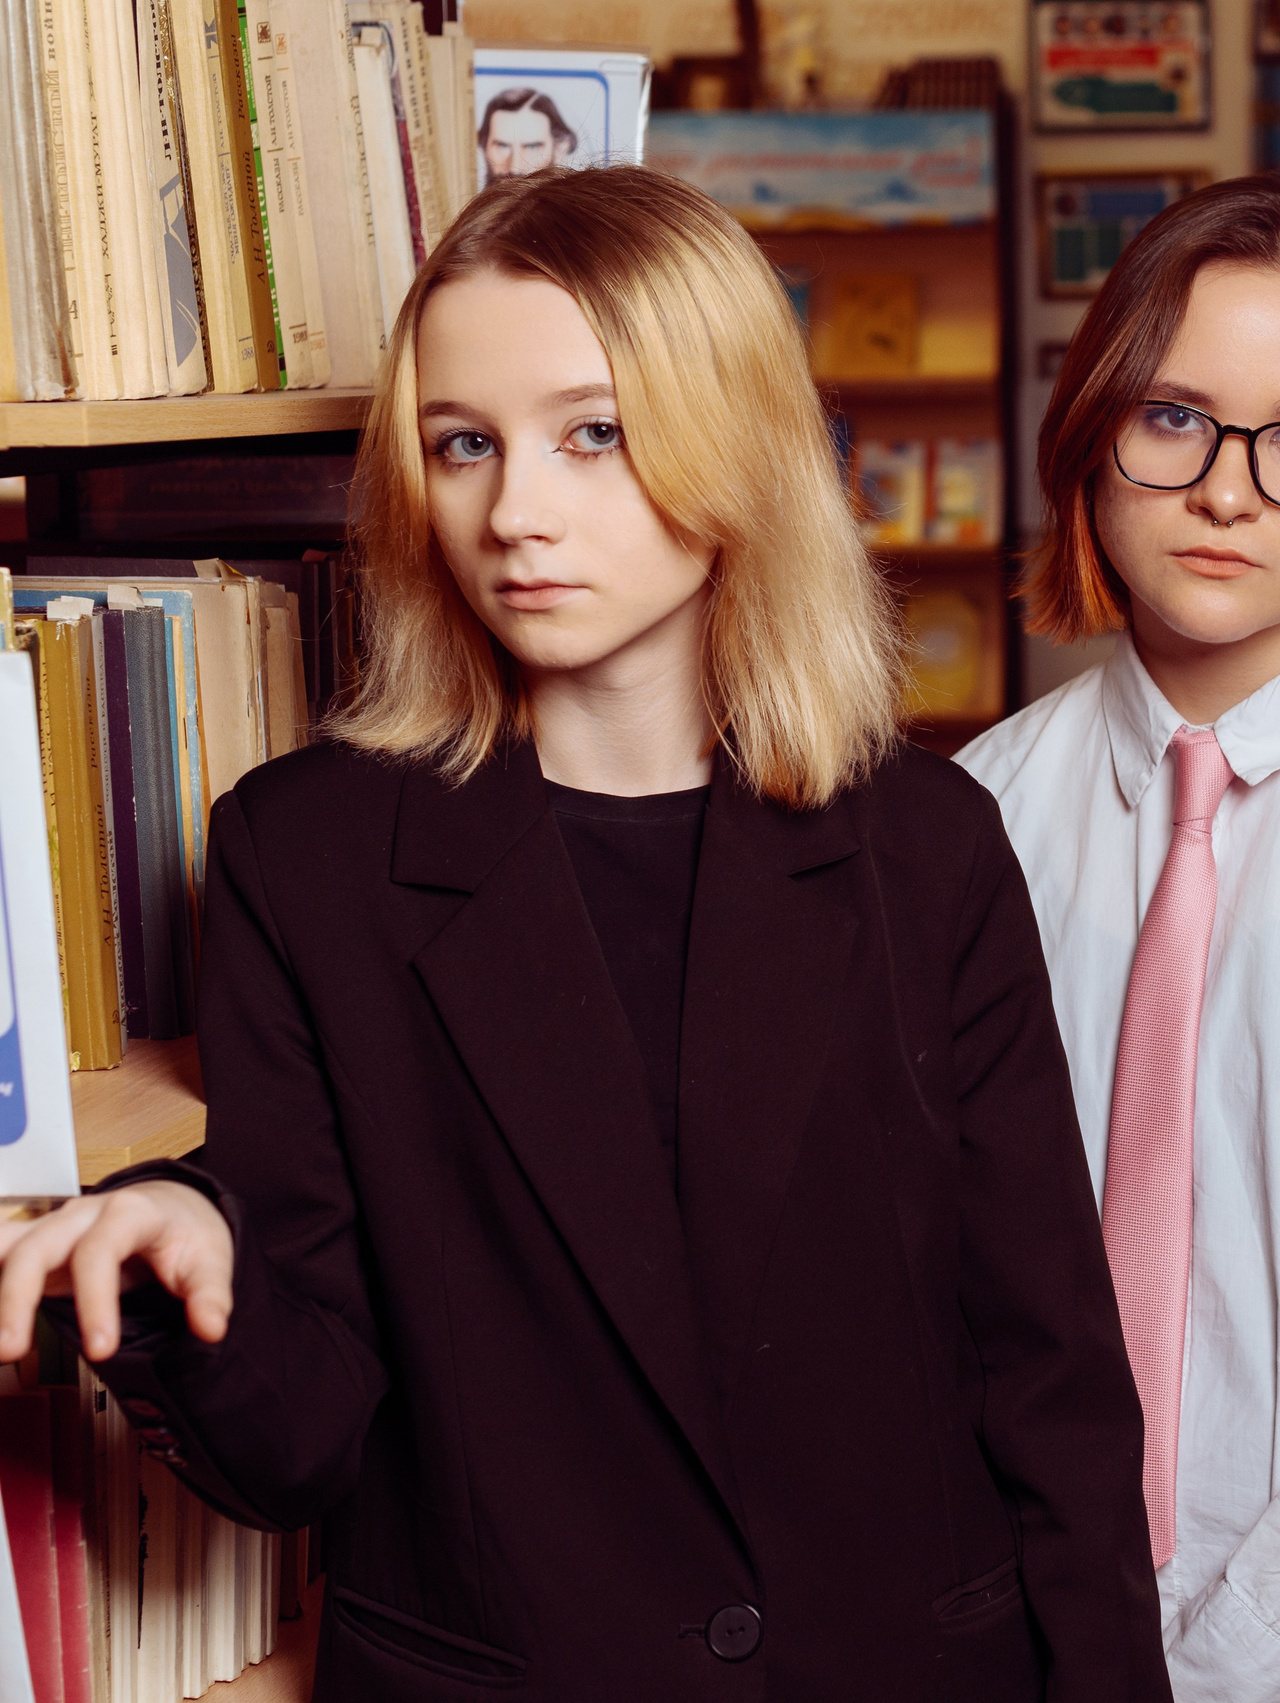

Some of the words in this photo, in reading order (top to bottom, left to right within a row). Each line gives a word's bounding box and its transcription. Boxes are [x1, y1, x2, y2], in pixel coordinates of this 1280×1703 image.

[230, 33, 246, 121] Рассказы
[90, 111, 110, 259] ХАДЖИ-МУРАТ
[265, 74, 276, 125] ТОЛСТОЙ
[273, 158, 284, 214] РАССКАЗЫ
[282, 80, 293, 130] ТОЛСТОЙ
[292, 161, 304, 216] РАССКАЗЫ
[244, 150, 264, 236] Толстой
[86, 675, 98, 769] Рассказы
[98, 803, 110, 900] Толстой
